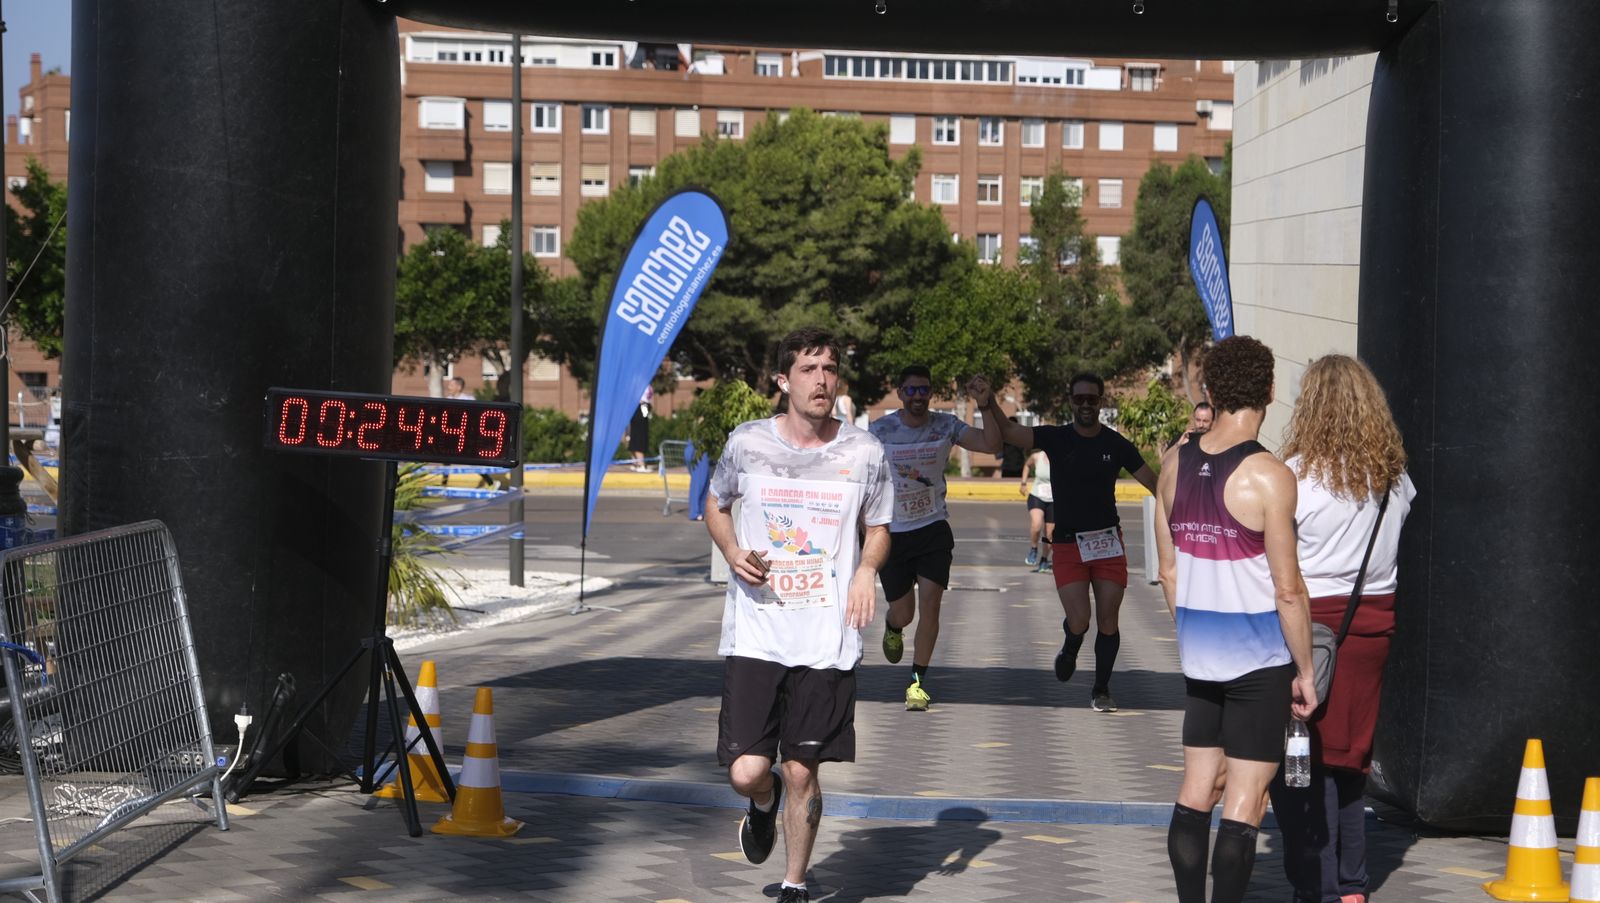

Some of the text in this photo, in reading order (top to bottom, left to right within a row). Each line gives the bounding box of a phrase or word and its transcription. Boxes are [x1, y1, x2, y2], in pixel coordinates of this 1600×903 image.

[657, 245, 722, 344] centrohogarsanchez.es
[279, 398, 505, 457] 00:24:49
[768, 488, 804, 499] CARRERA
[806, 491, 819, 500] SIN
[821, 492, 843, 502] HUMO
[901, 496, 931, 512] 1263
[819, 517, 840, 526] JUNIO
[1085, 537, 1114, 551] 1257
[768, 571, 824, 592] 1032
